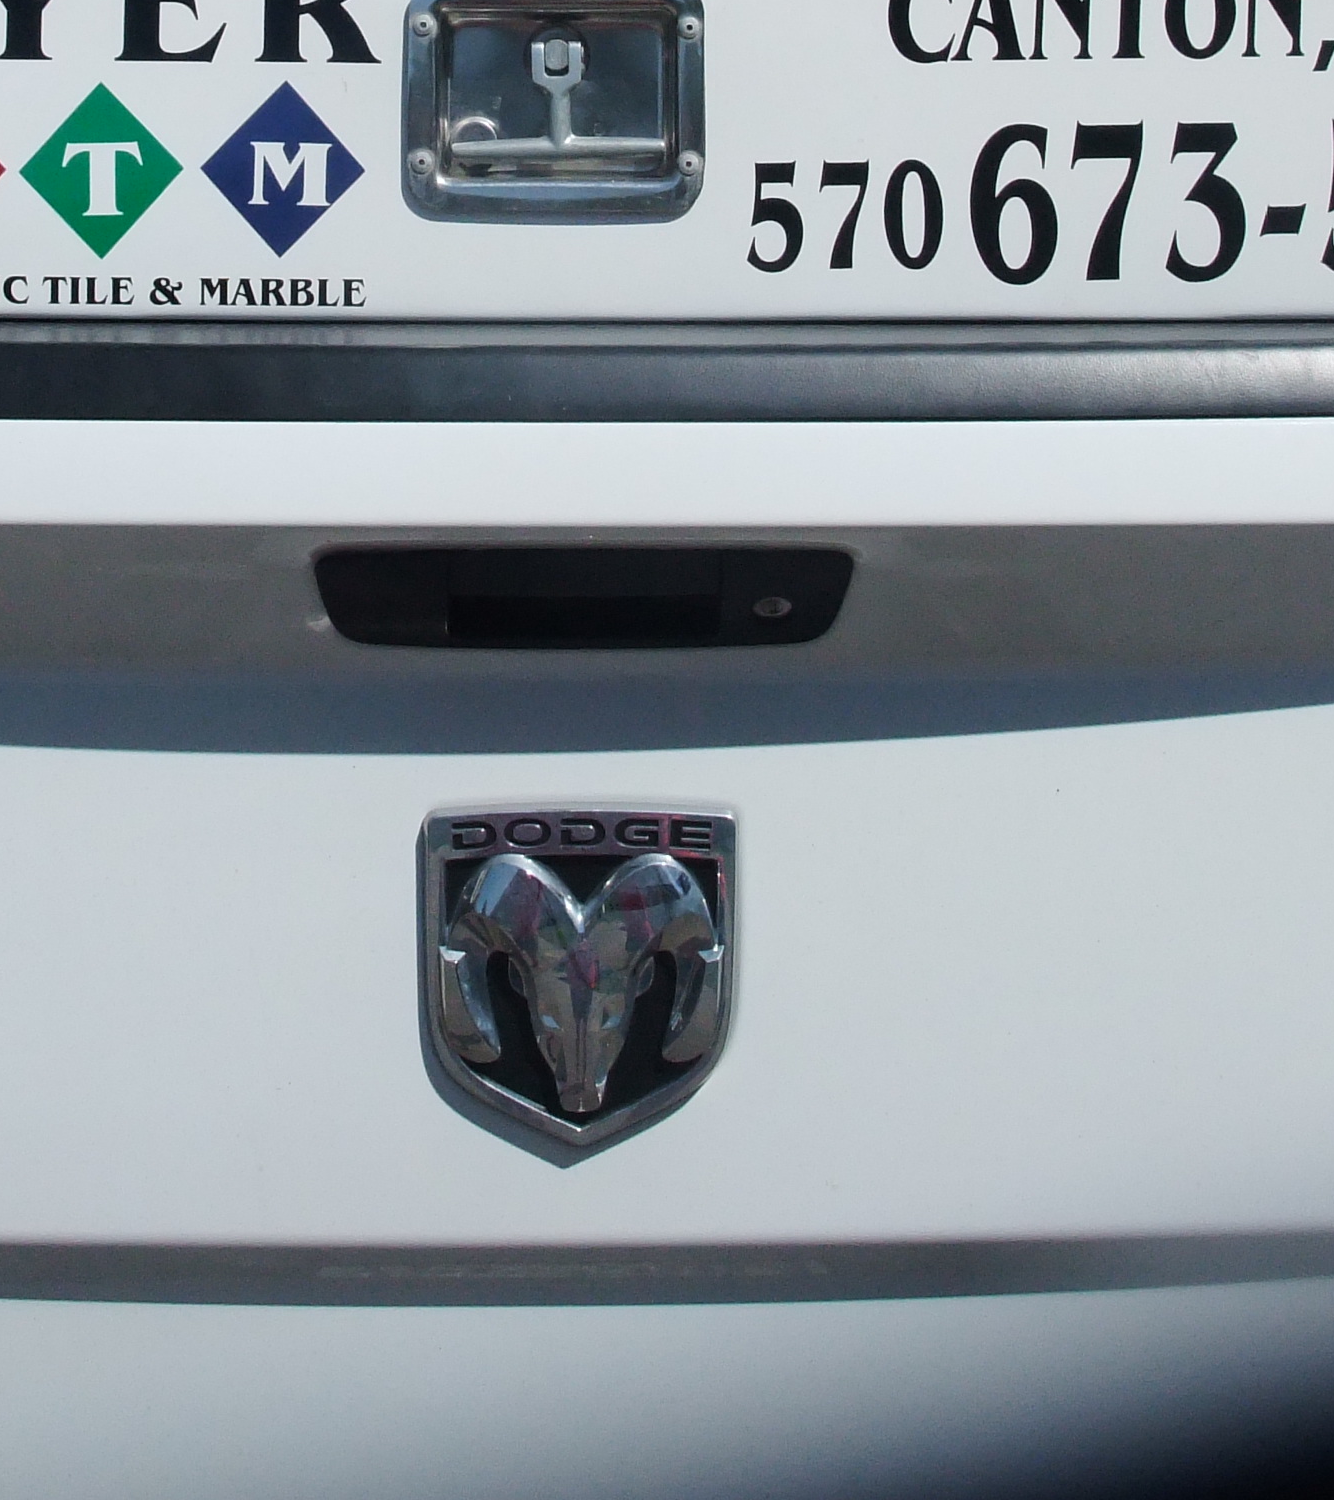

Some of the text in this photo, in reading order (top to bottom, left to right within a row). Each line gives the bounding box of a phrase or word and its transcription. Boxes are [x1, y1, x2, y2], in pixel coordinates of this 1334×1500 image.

[61, 141, 144, 217] T
[249, 141, 333, 207] M
[747, 159, 944, 274] 570
[42, 275, 135, 306] TILE
[149, 276, 183, 307] &
[200, 277, 366, 308] MARBLE
[450, 817, 713, 850] DODGE
